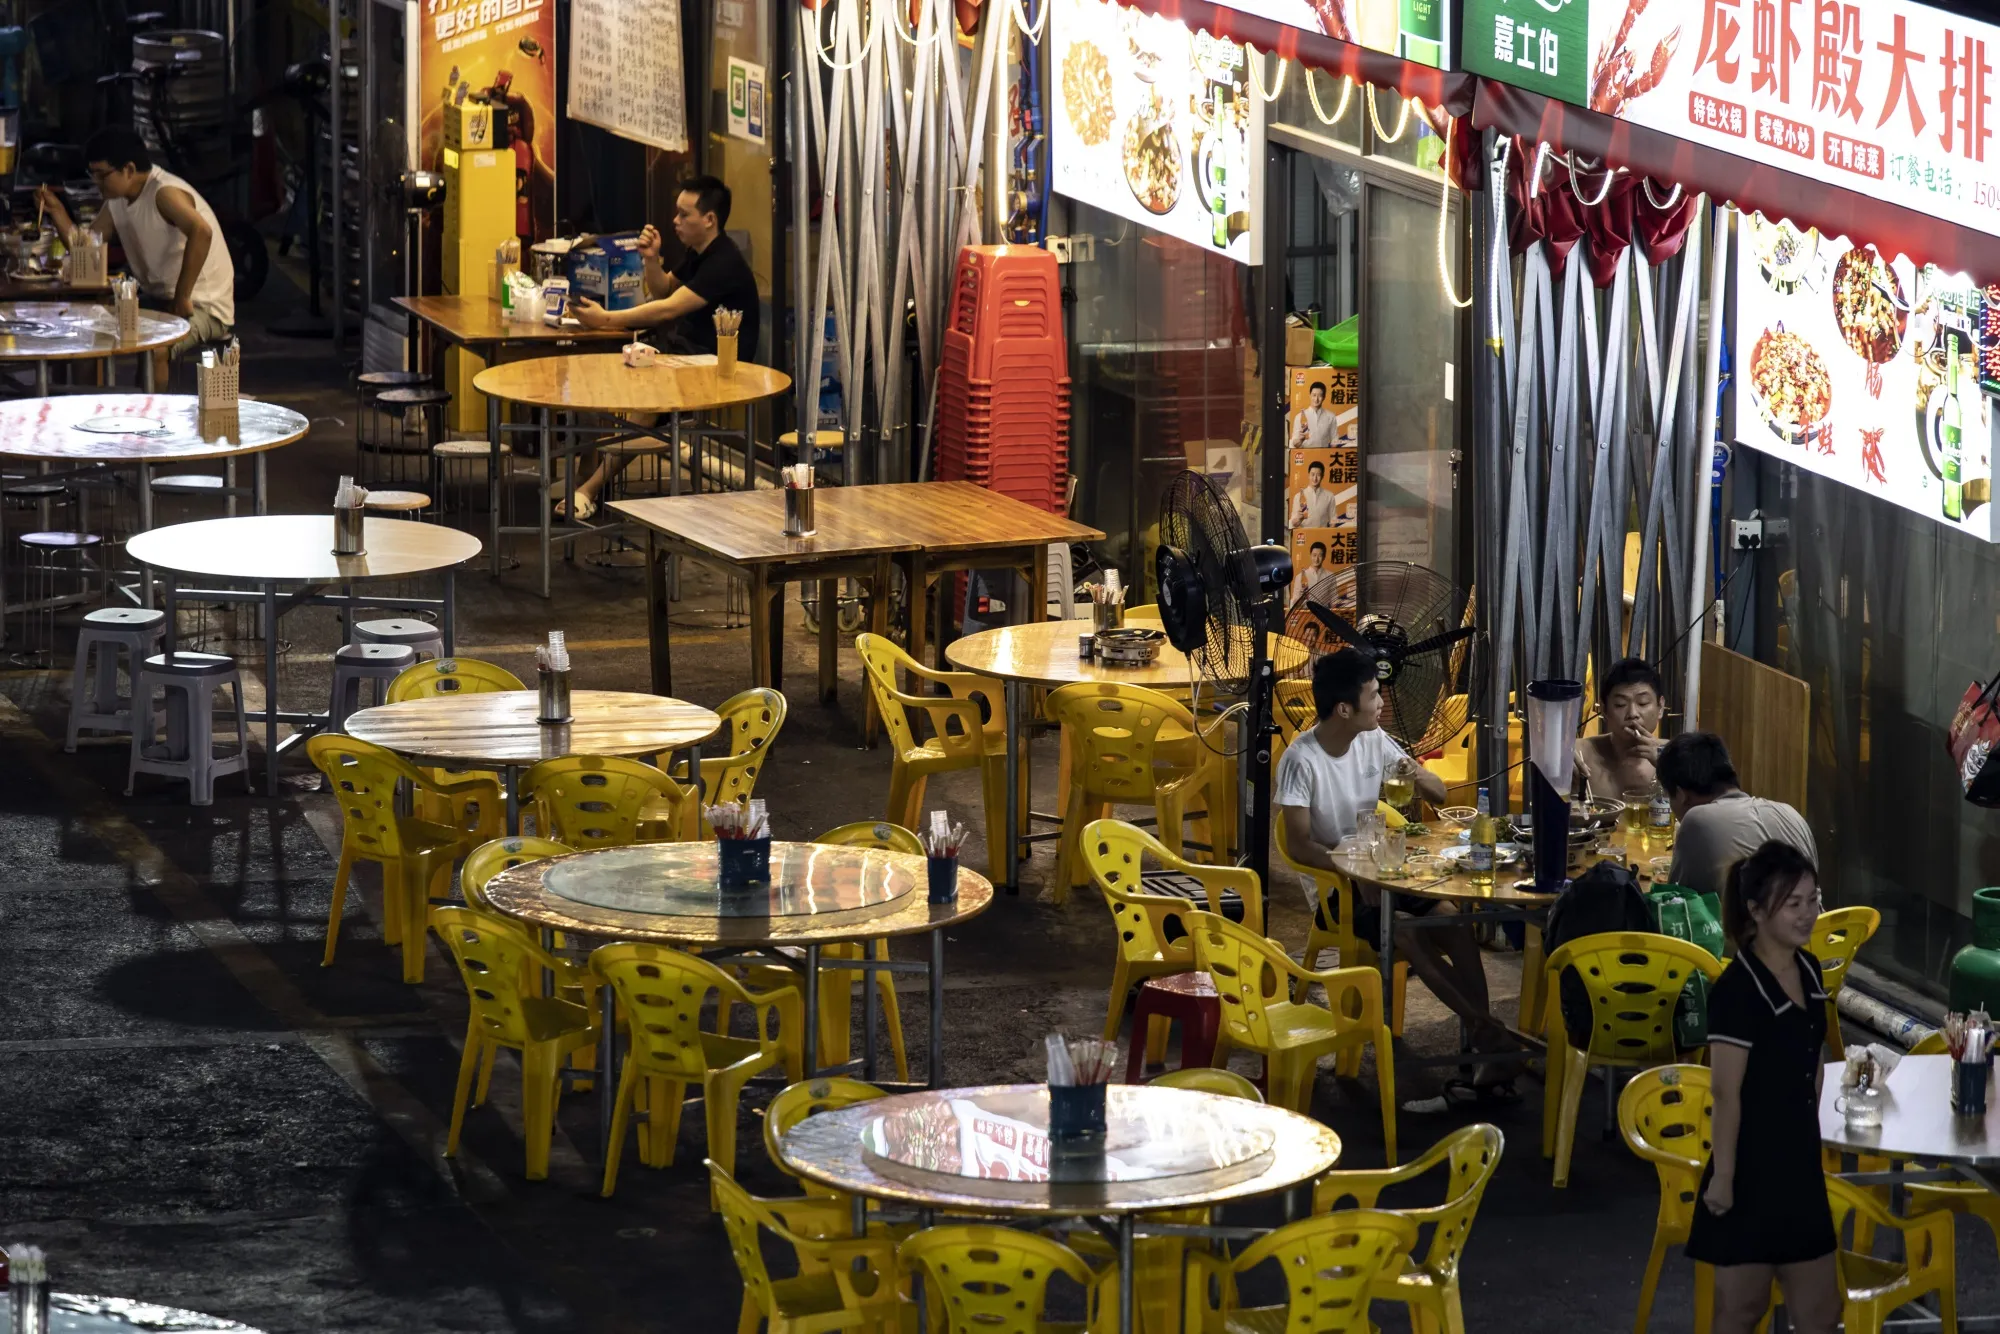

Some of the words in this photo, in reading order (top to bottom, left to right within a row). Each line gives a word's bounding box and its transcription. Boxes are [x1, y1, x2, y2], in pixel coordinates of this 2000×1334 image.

[1413, 1, 1431, 15] LIGHT
[1494, 14, 1559, 77] 嘉士伯
[1693, 96, 1743, 134] 特色火锅
[1759, 116, 1810, 154] 家常小炒
[1827, 136, 1880, 176] 开胃凉菜
